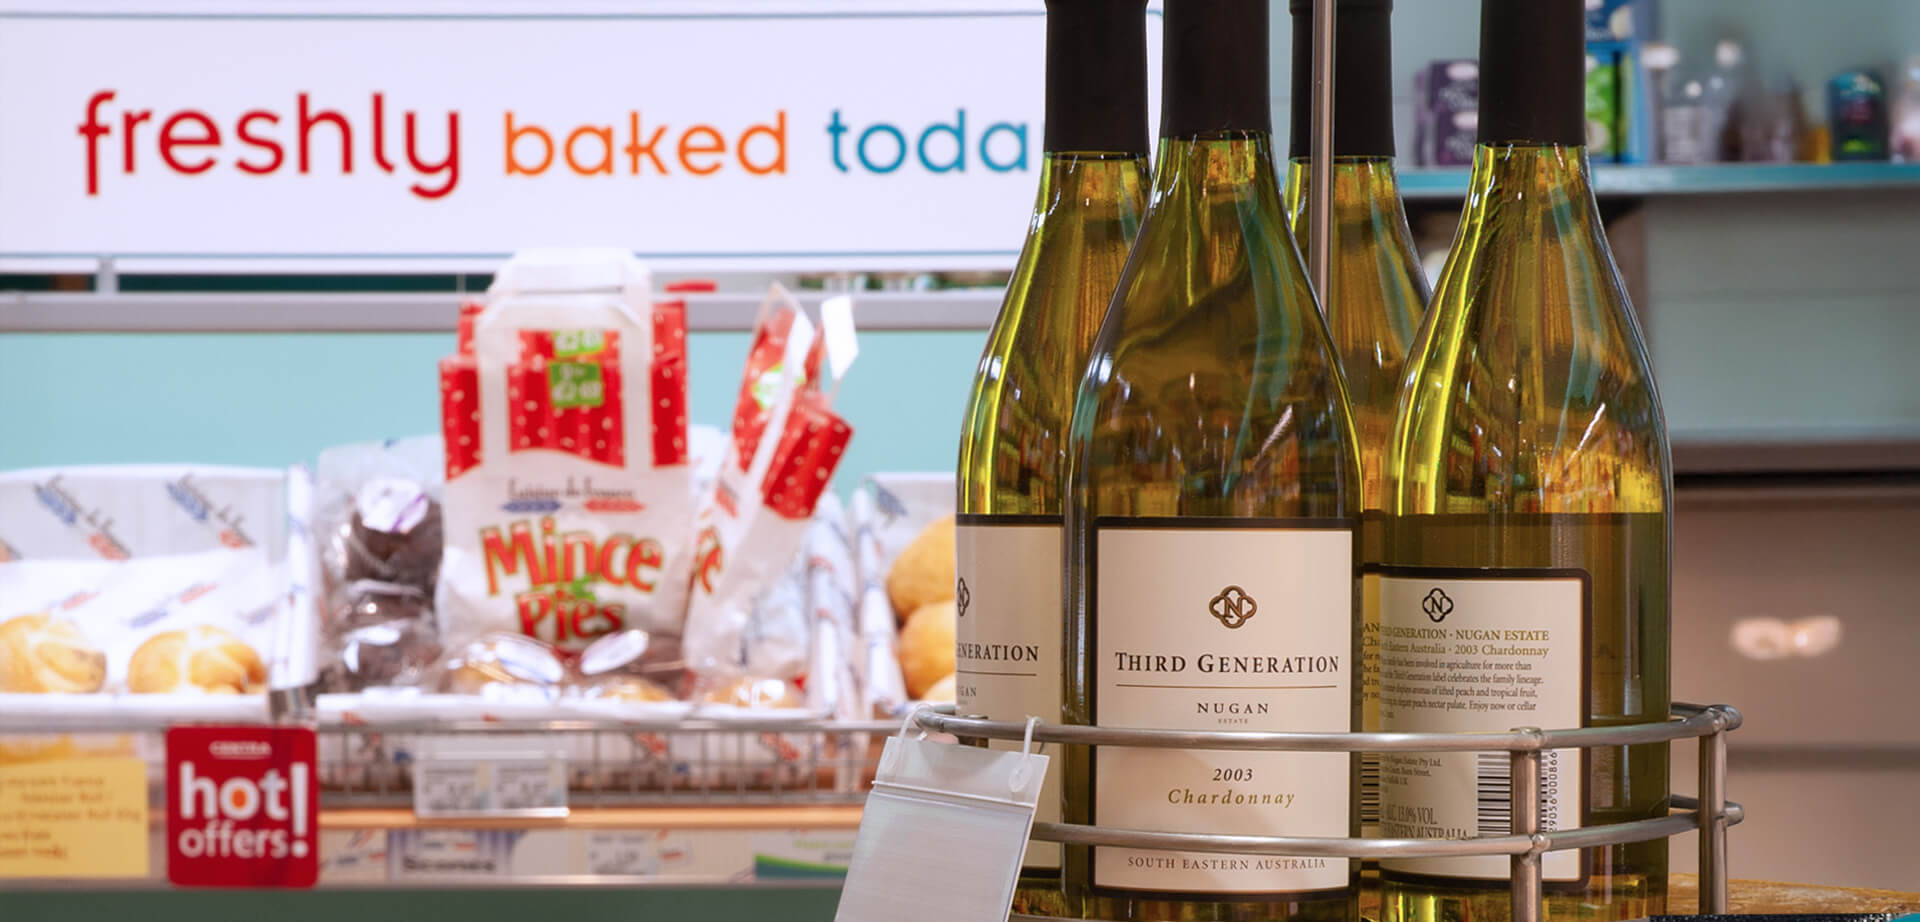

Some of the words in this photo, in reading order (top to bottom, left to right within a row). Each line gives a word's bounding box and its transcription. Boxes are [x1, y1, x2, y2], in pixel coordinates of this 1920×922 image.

[78, 90, 460, 200] freshly
[504, 110, 788, 176] baked
[826, 108, 1029, 174] toda
[480, 516, 664, 597] Mince
[515, 587, 626, 643] Pies
[1455, 630, 1500, 641] NUGAN
[1503, 630, 1550, 641] ESTATE
[1454, 644, 1479, 655] 2003
[1481, 645, 1550, 659] Chardonnay
[1115, 652, 1187, 673] THIRD
[1197, 654, 1339, 674] GENERATION
[1447, 659, 1481, 672] agriculture
[1483, 660, 1493, 670] for
[1515, 661, 1532, 670] than
[1448, 672, 1479, 683] celebrates
[1480, 674, 1491, 683] the
[1493, 674, 1515, 686] family
[1516, 674, 1544, 686] lineage.
[1456, 687, 1475, 698] peach
[1476, 687, 1489, 696] and
[1490, 688, 1518, 699] tropical
[1519, 688, 1538, 698] fruit,
[1197, 703, 1269, 714] NUGAN
[1469, 701, 1489, 712] Enjoy
[1517, 702, 1536, 711] cellar
[1213, 768, 1253, 782] 2003
[1548, 751, 1558, 795] 000866
[1167, 789, 1296, 809] Chardonnay
[1548, 798, 1558, 832] 29056
[178, 820, 290, 859] offers
[1127, 856, 1176, 869] SOUTH
[1182, 858, 1250, 870] EASTERN
[1255, 859, 1326, 870] AUSTRALIA
